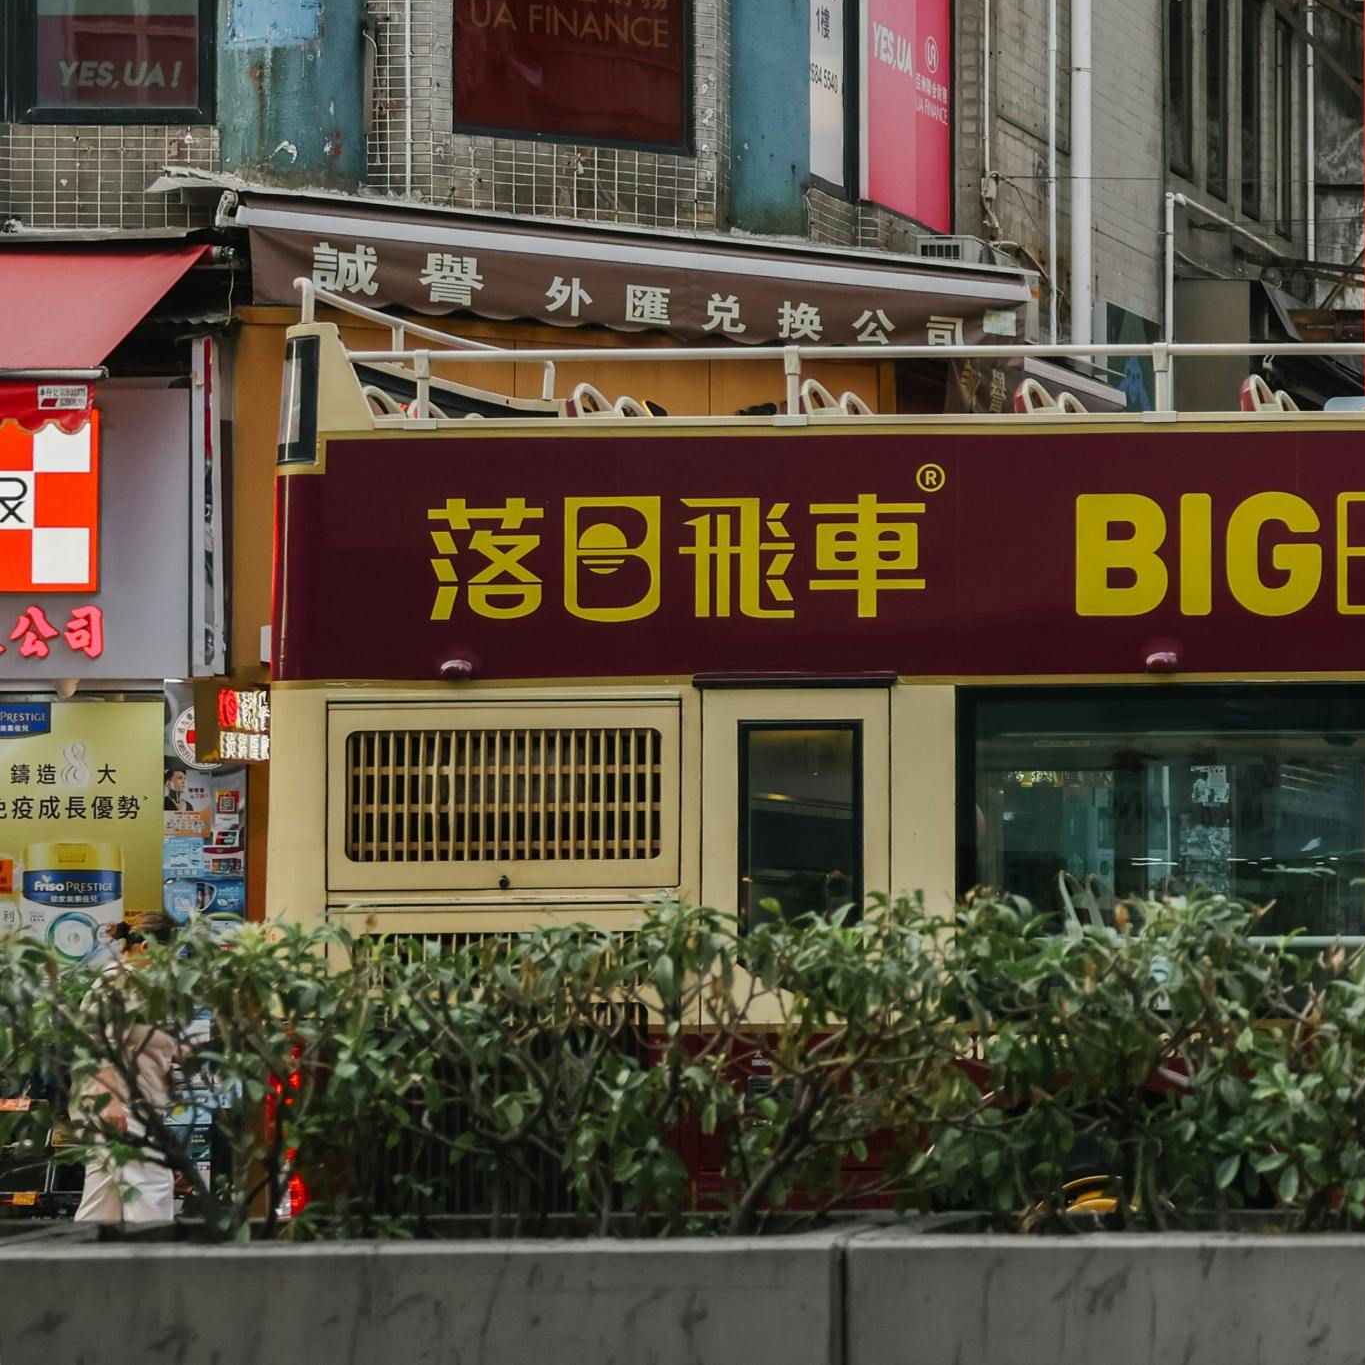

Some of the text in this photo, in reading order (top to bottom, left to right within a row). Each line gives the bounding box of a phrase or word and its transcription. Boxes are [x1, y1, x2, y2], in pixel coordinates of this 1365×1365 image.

[528, 4, 669, 48] FINANCE
[0, 606, 104, 659] 公司
[66, 881, 113, 893] PRESTIGE
